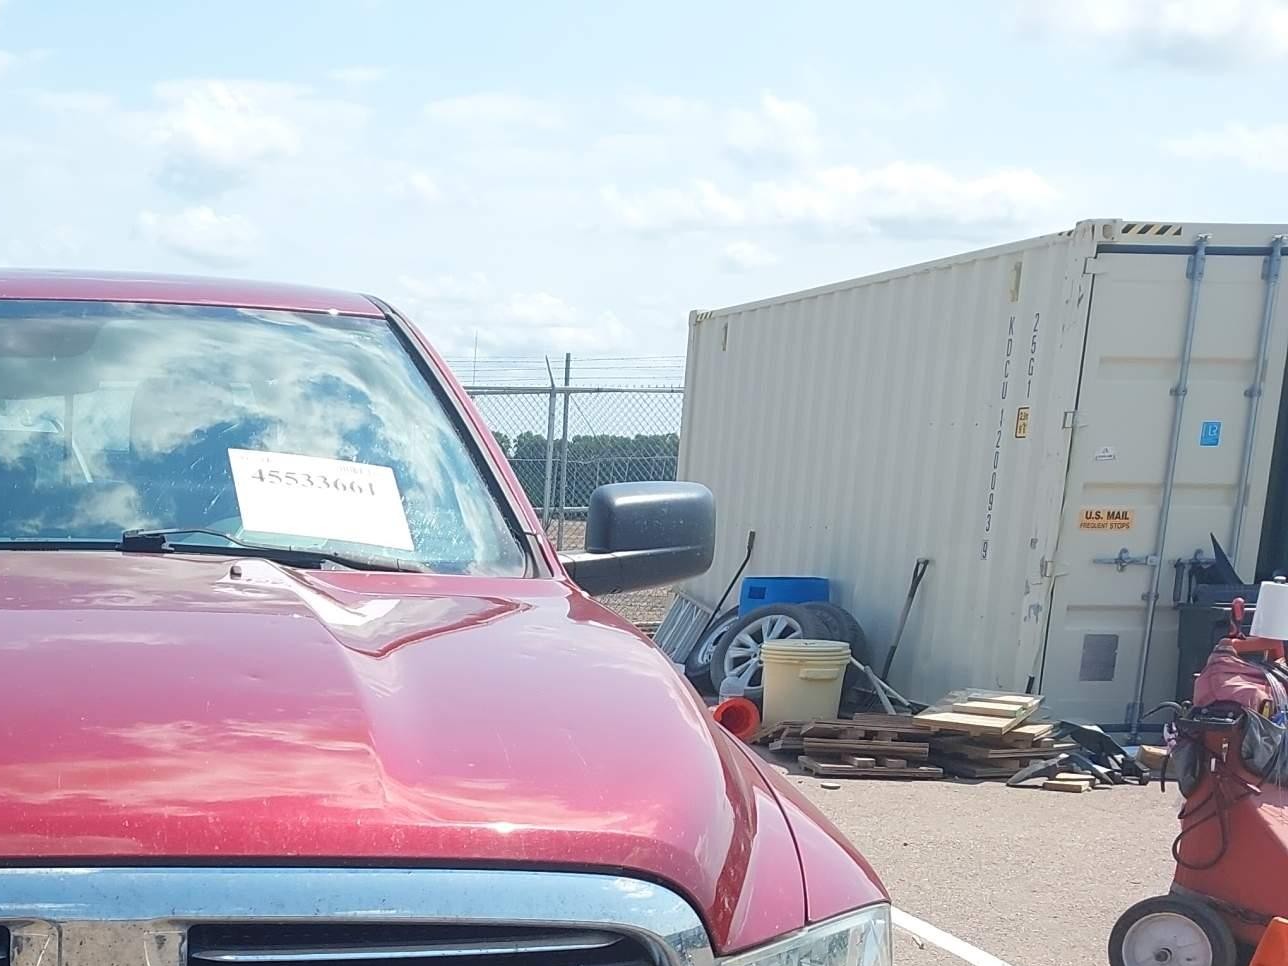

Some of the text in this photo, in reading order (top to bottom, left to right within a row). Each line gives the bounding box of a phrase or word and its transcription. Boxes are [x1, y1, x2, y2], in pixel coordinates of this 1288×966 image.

[1001, 315, 1016, 400] KDCU
[1026, 312, 1040, 399] 25G1
[251, 468, 375, 496] 45533661
[985, 408, 1004, 532] 120093
[1085, 510, 1130, 520] U.S. MAIL
